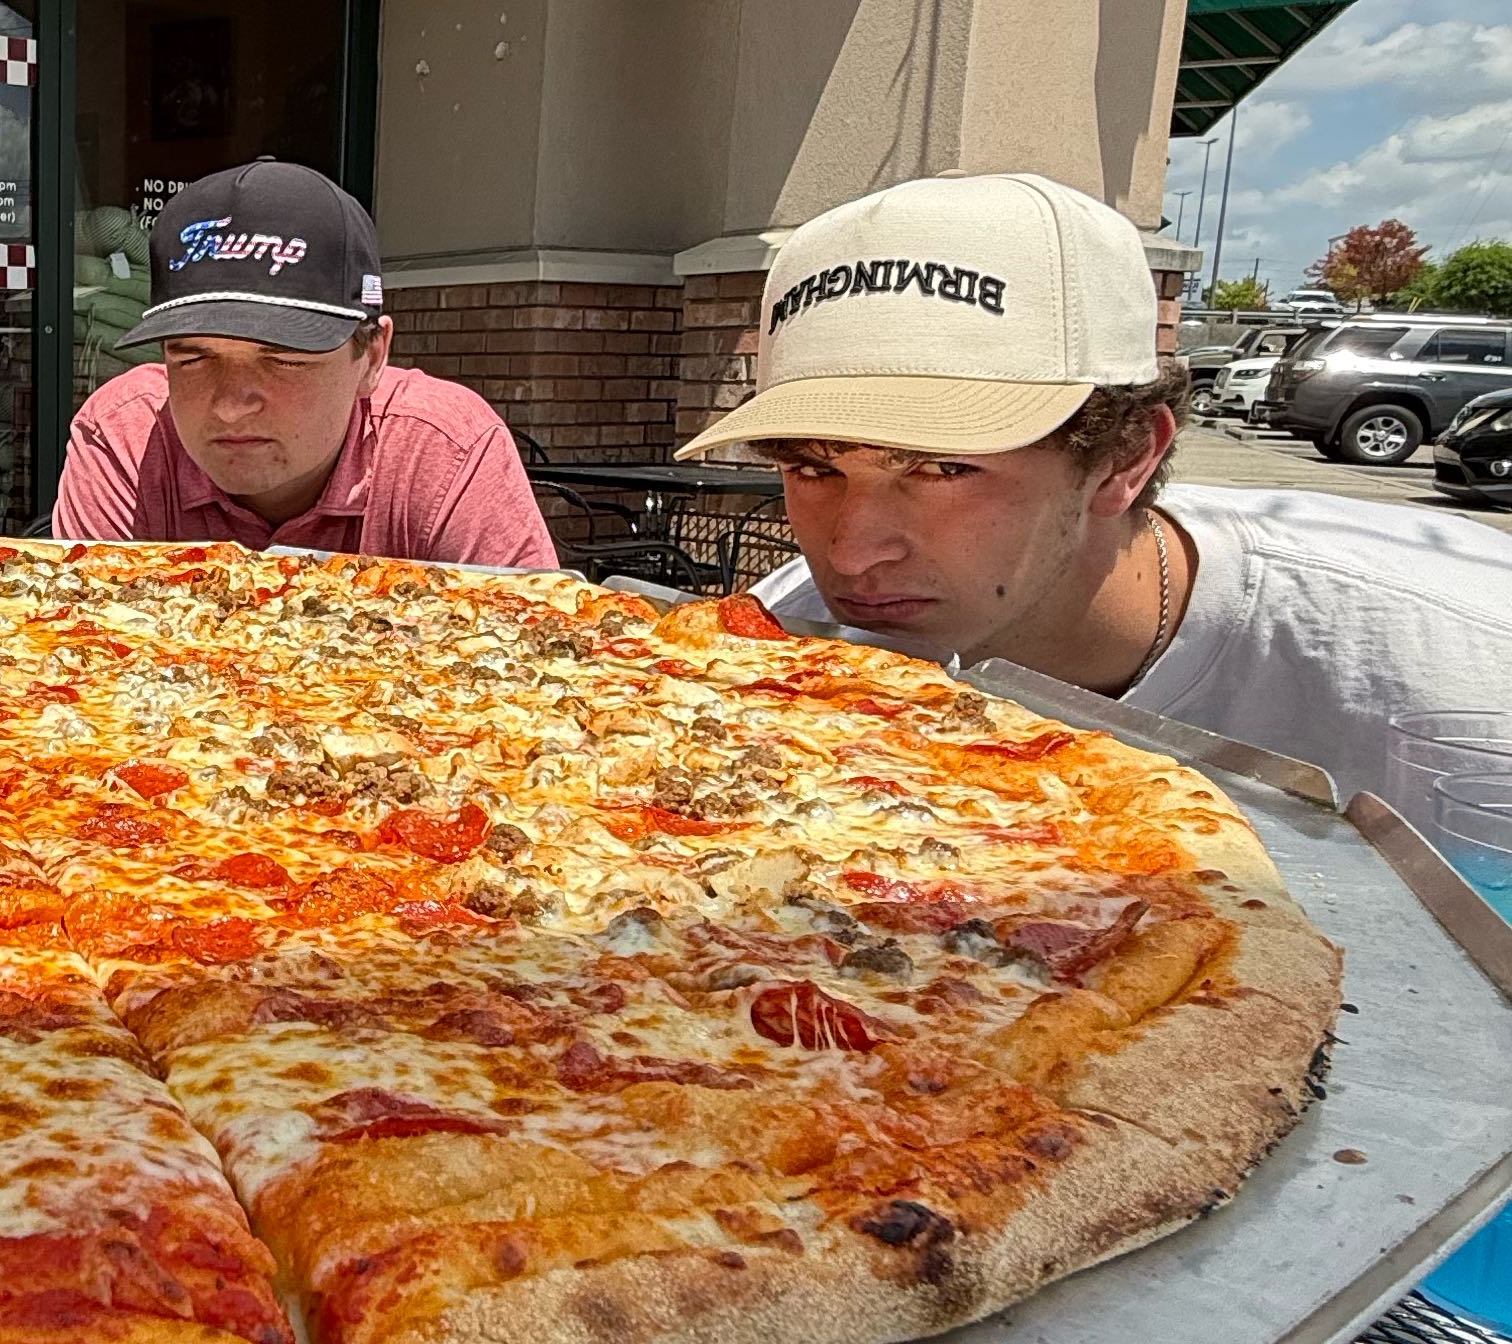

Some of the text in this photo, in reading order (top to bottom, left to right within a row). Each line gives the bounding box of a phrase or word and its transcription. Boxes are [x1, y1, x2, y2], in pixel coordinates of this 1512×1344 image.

[143, 197, 164, 211] NO
[144, 178, 164, 193] NO
[169, 214, 308, 276] Trump
[767, 259, 1007, 337] BIRMINGHAM
